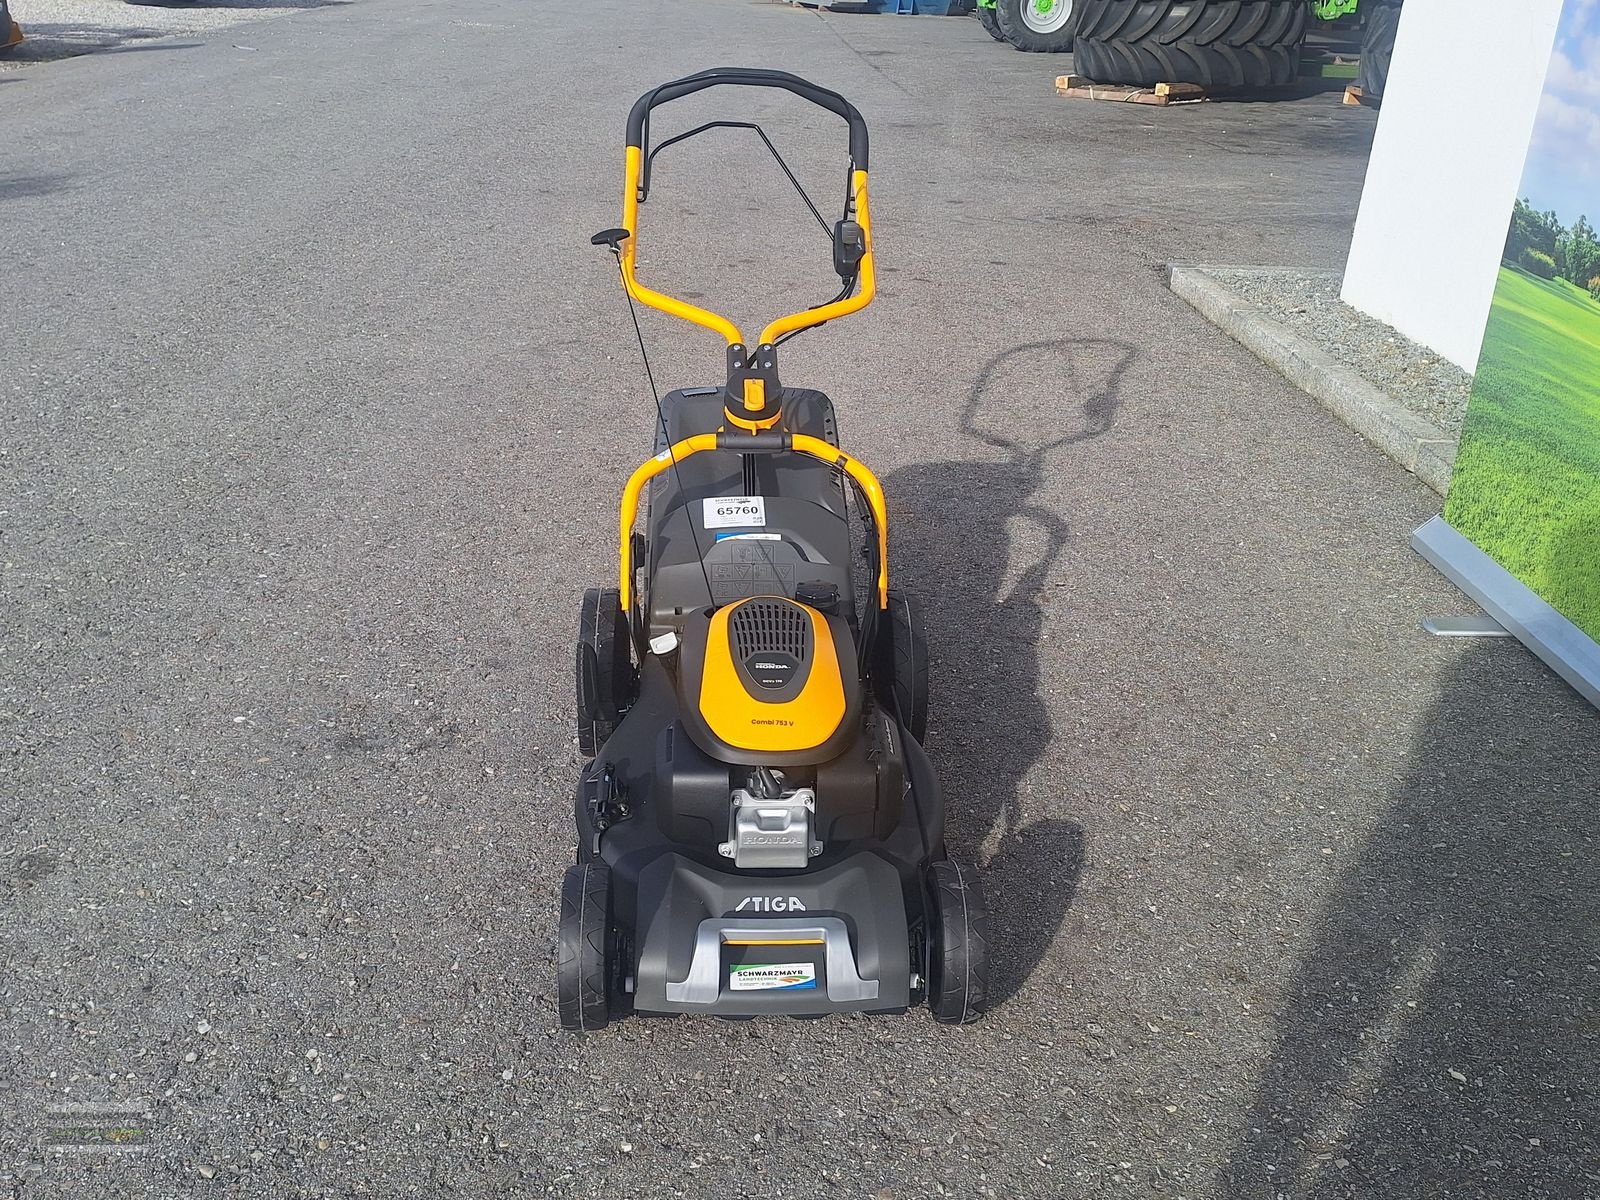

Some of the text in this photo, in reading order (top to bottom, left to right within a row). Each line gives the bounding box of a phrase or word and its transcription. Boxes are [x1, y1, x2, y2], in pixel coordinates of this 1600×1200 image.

[717, 506, 758, 515] 65760
[775, 719, 788, 727] 753
[742, 836, 803, 846] HONDA
[735, 896, 806, 912] STIGA
